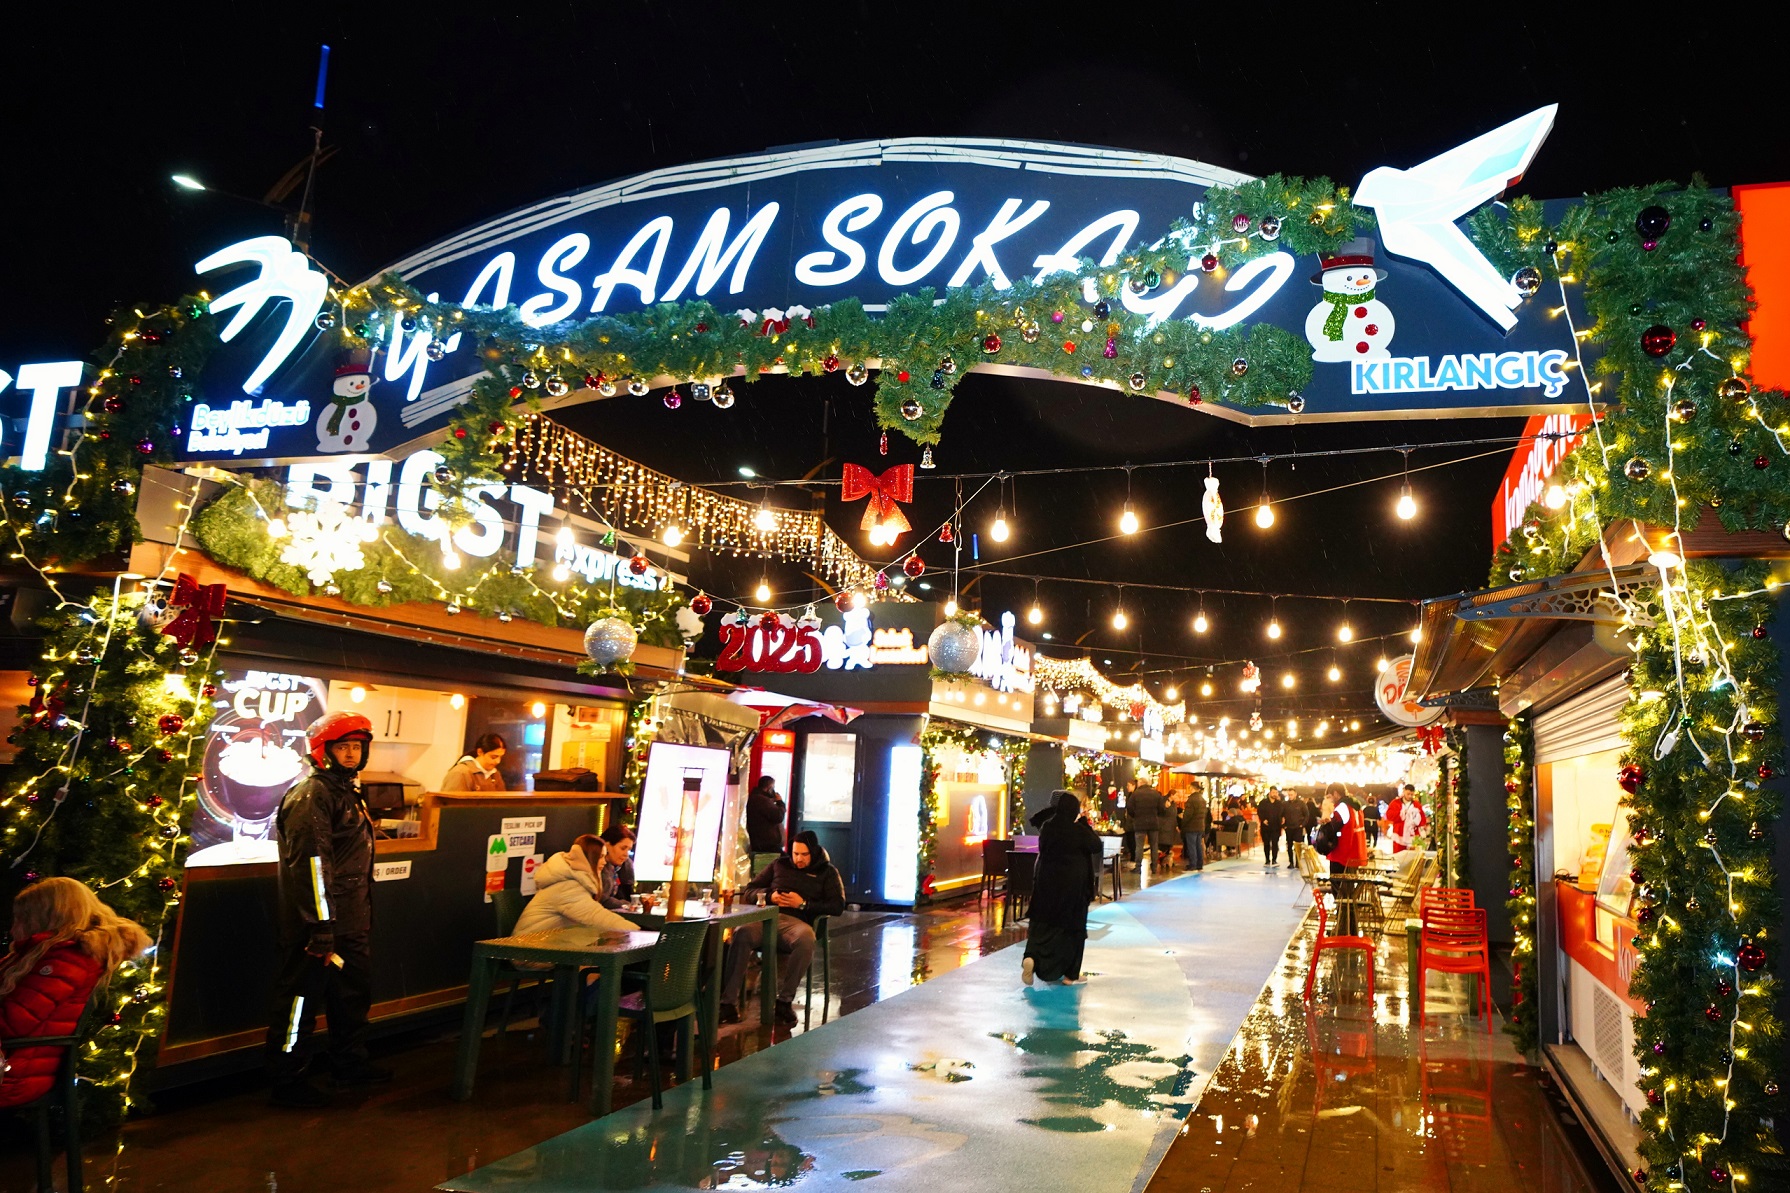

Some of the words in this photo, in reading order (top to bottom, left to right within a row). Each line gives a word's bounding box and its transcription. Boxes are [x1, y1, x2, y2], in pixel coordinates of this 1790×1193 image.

[1351, 350, 1569, 397] KIRLANGIÇ
[717, 613, 822, 673] 2025
[234, 687, 309, 721] CUP
[385, 866, 407, 876] ORDER
